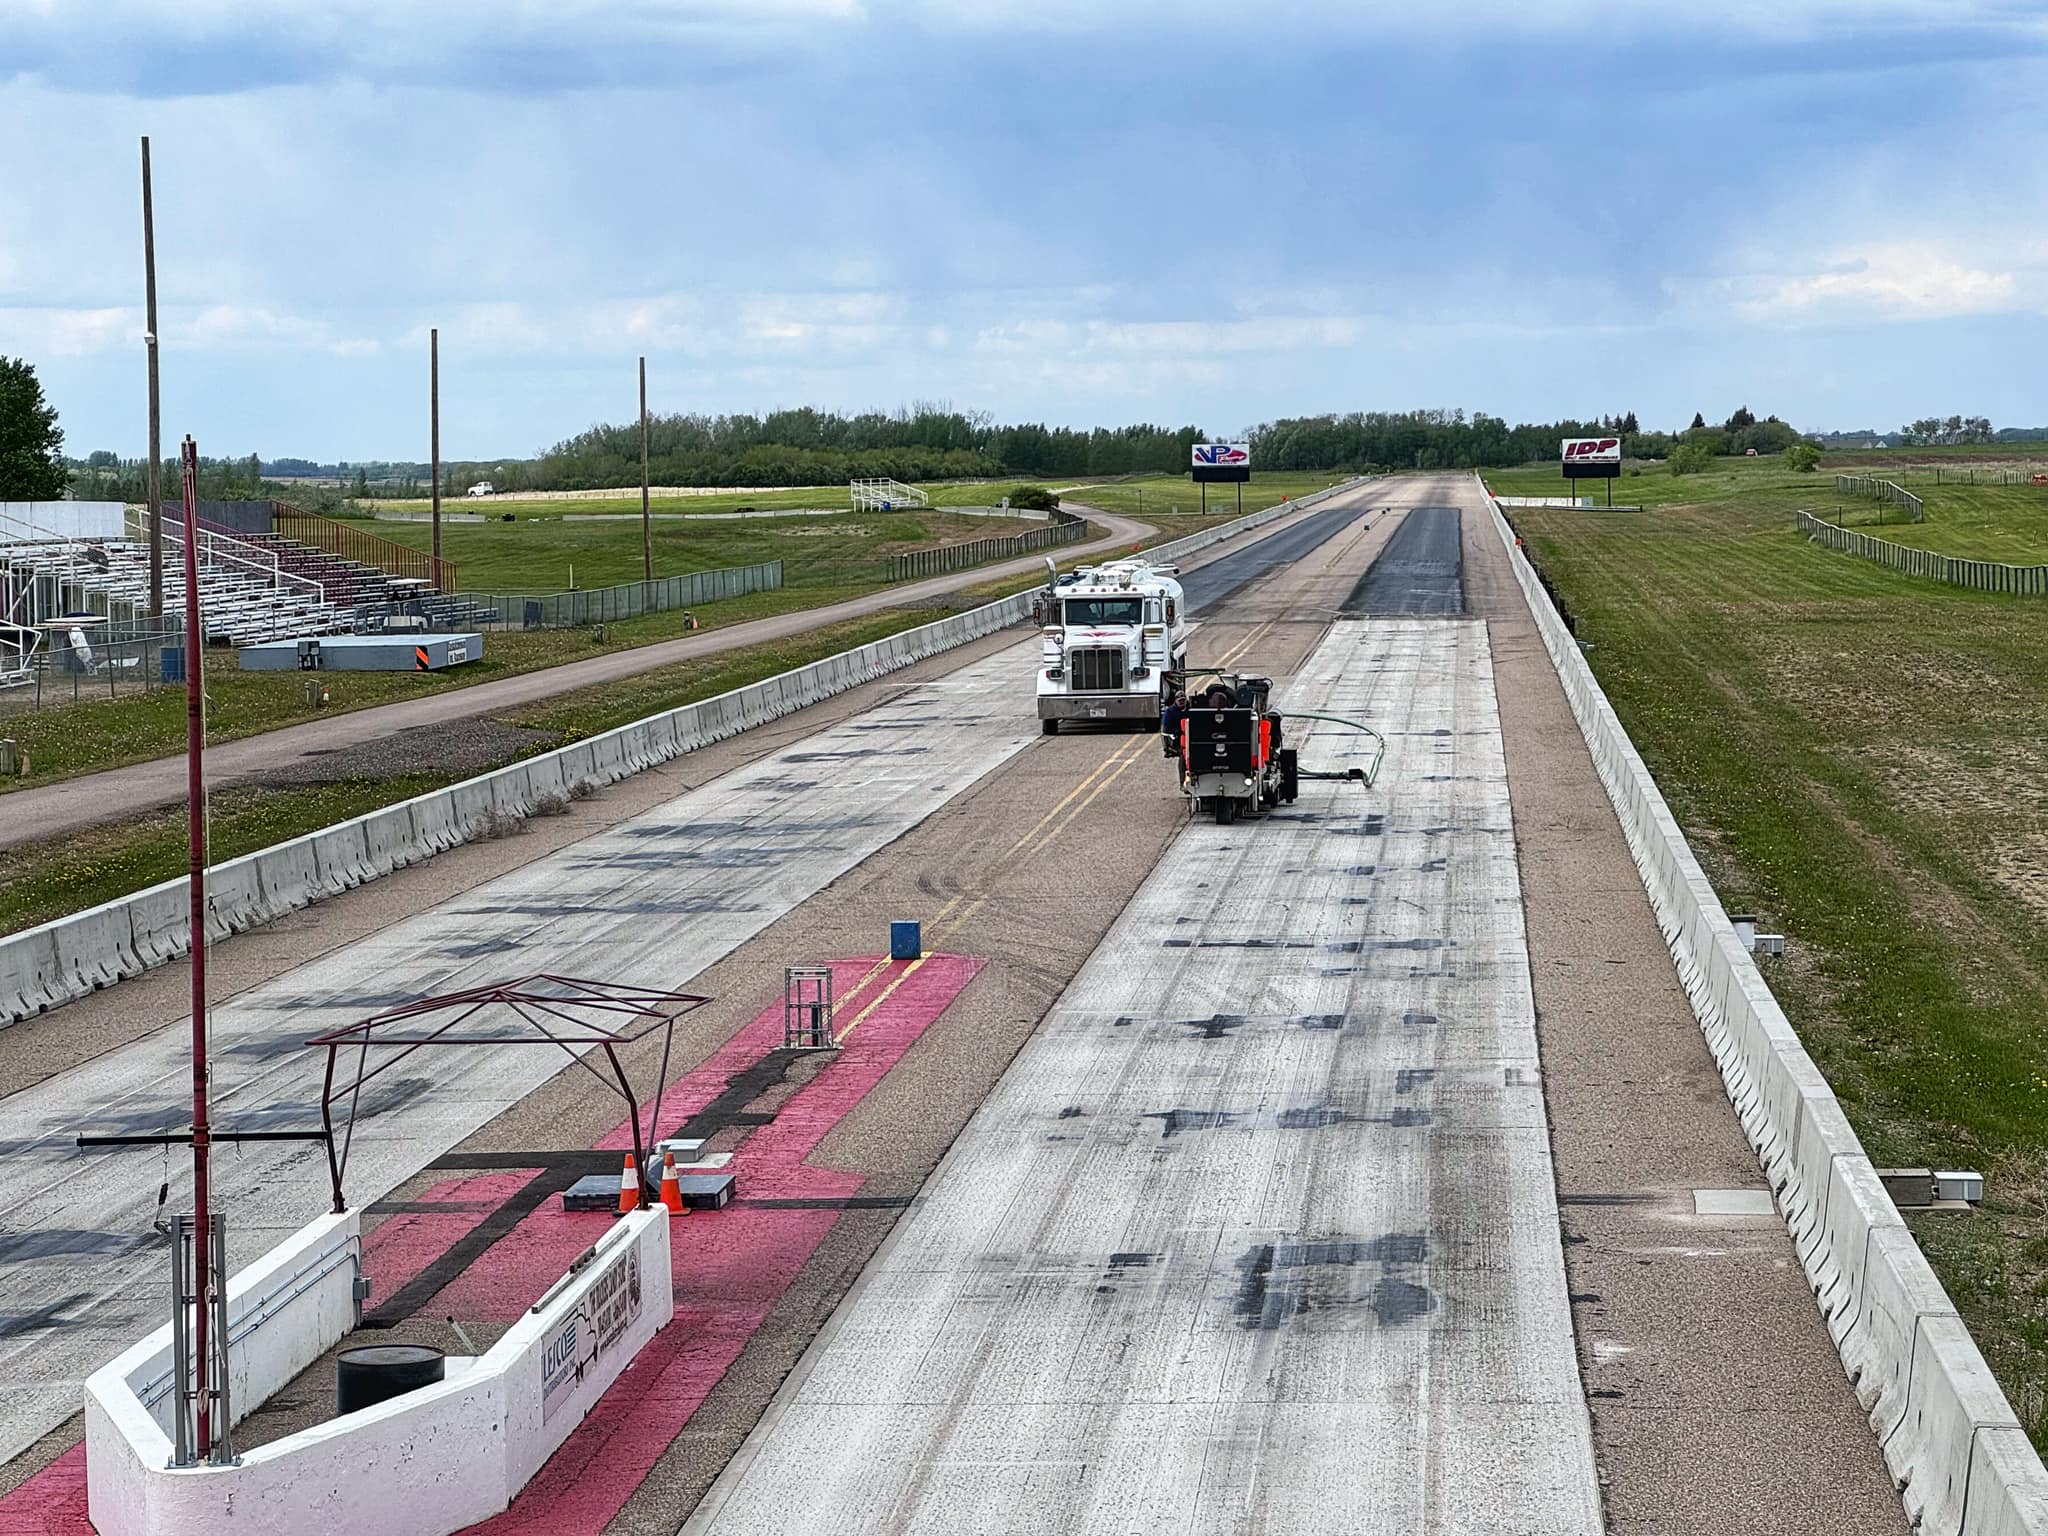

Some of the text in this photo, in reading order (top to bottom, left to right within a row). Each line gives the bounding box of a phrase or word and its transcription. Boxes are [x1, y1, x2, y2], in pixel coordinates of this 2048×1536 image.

[1196, 446, 1231, 464] VP
[1565, 440, 1618, 456] IDP
[543, 1331, 569, 1382] LESCO
